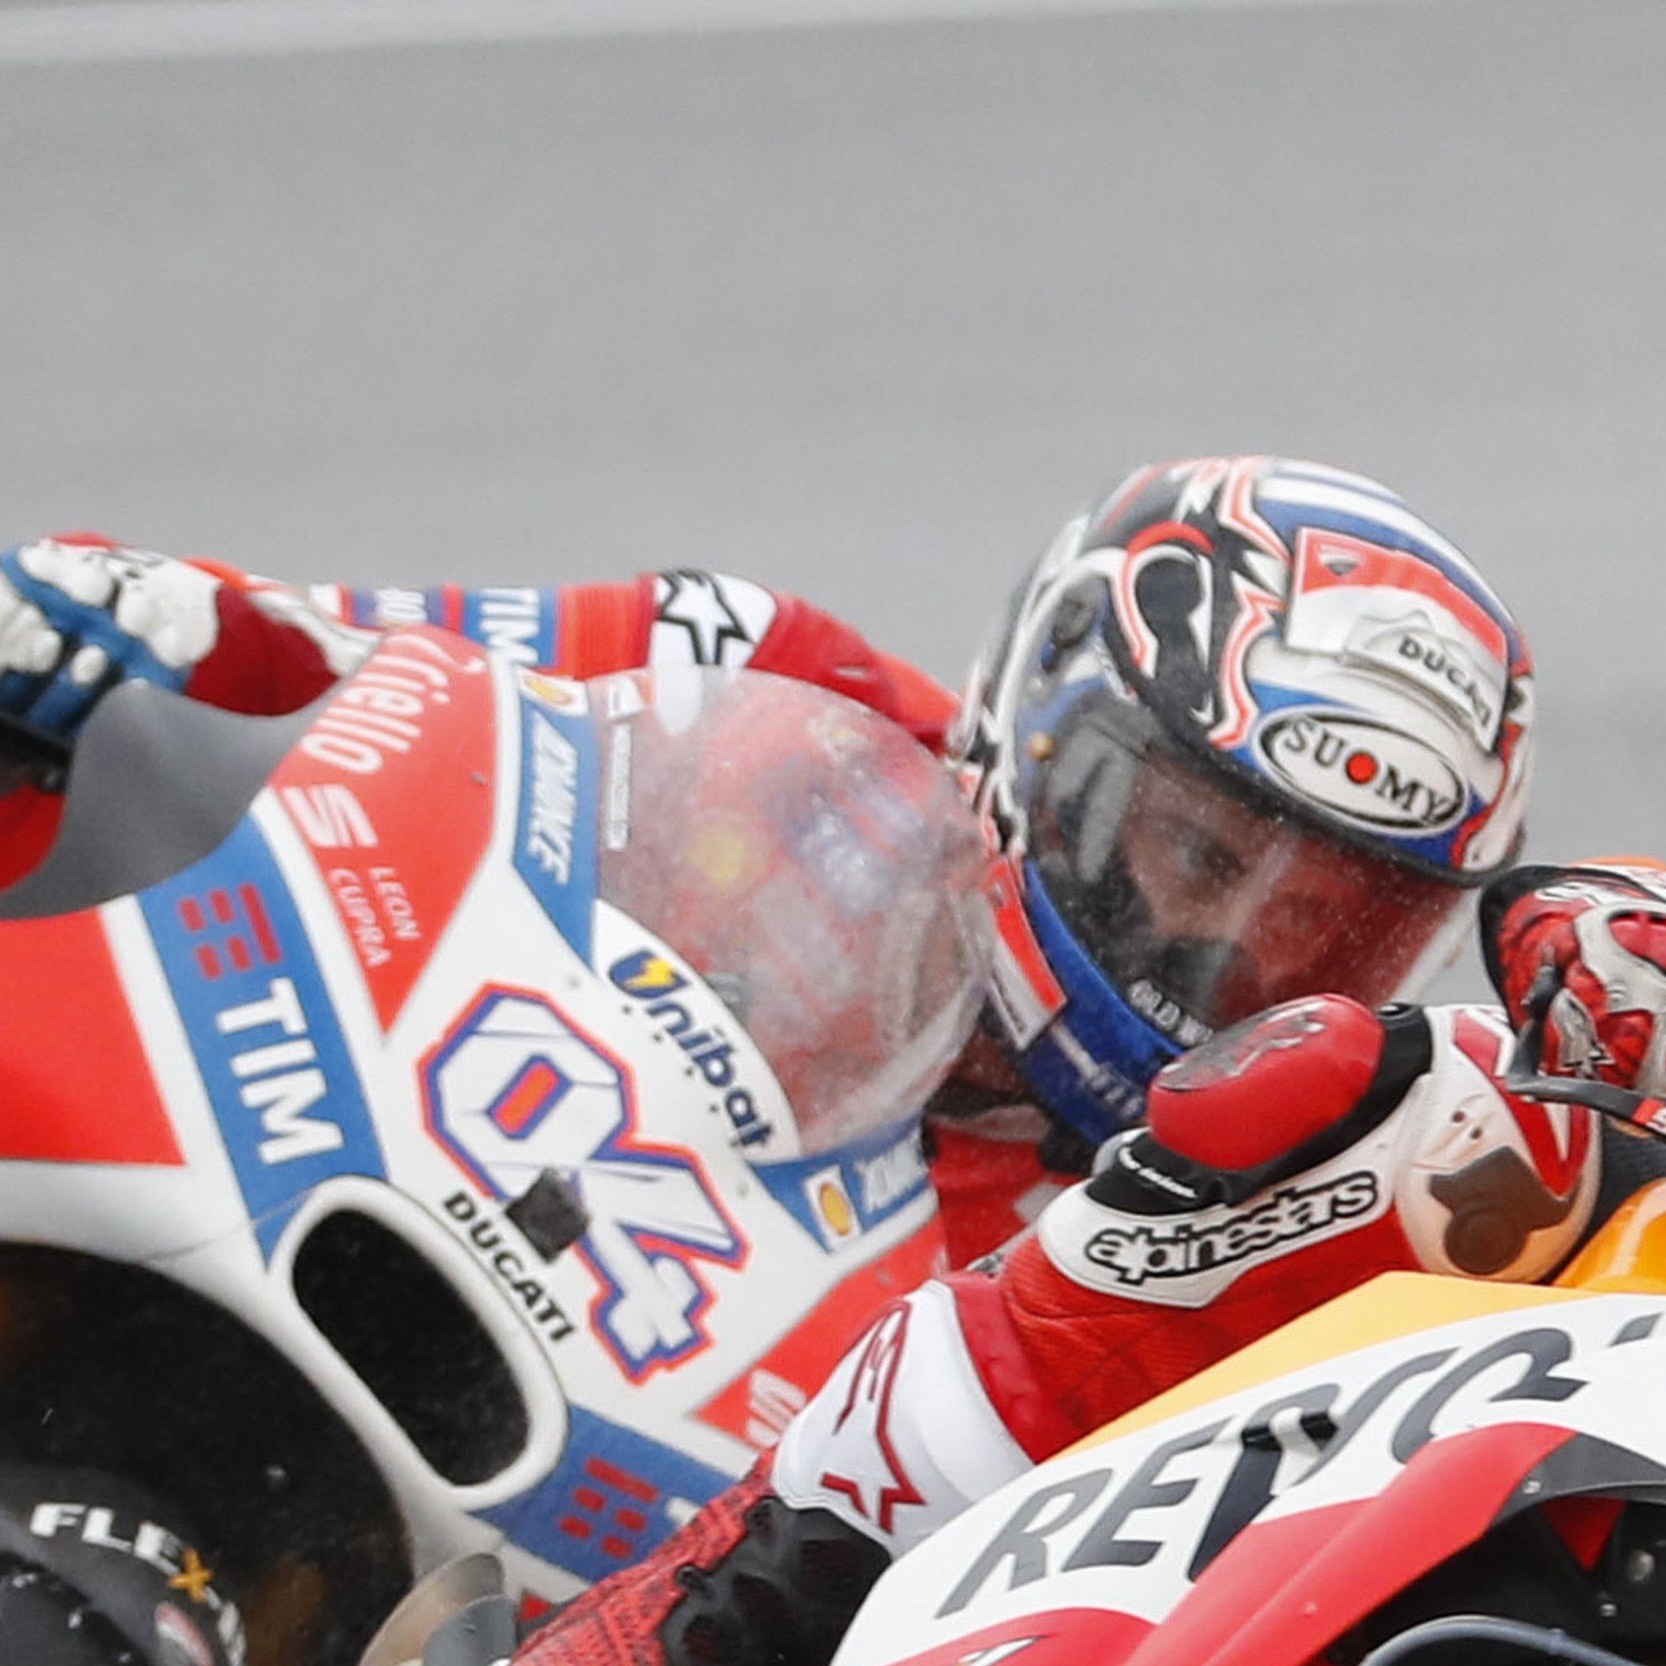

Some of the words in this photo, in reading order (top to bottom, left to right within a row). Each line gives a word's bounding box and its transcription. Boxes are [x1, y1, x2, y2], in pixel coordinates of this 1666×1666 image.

[1281, 722, 1448, 824] SUOMY
[332, 868, 387, 967] CUPRA
[369, 866, 421, 940] LEON
[216, 978, 343, 1166] TIM
[607, 950, 777, 1150] Unibat
[417, 981, 749, 1385] 04
[1081, 1170, 1379, 1283] alpinestars
[441, 1193, 575, 1343] DUCATI
